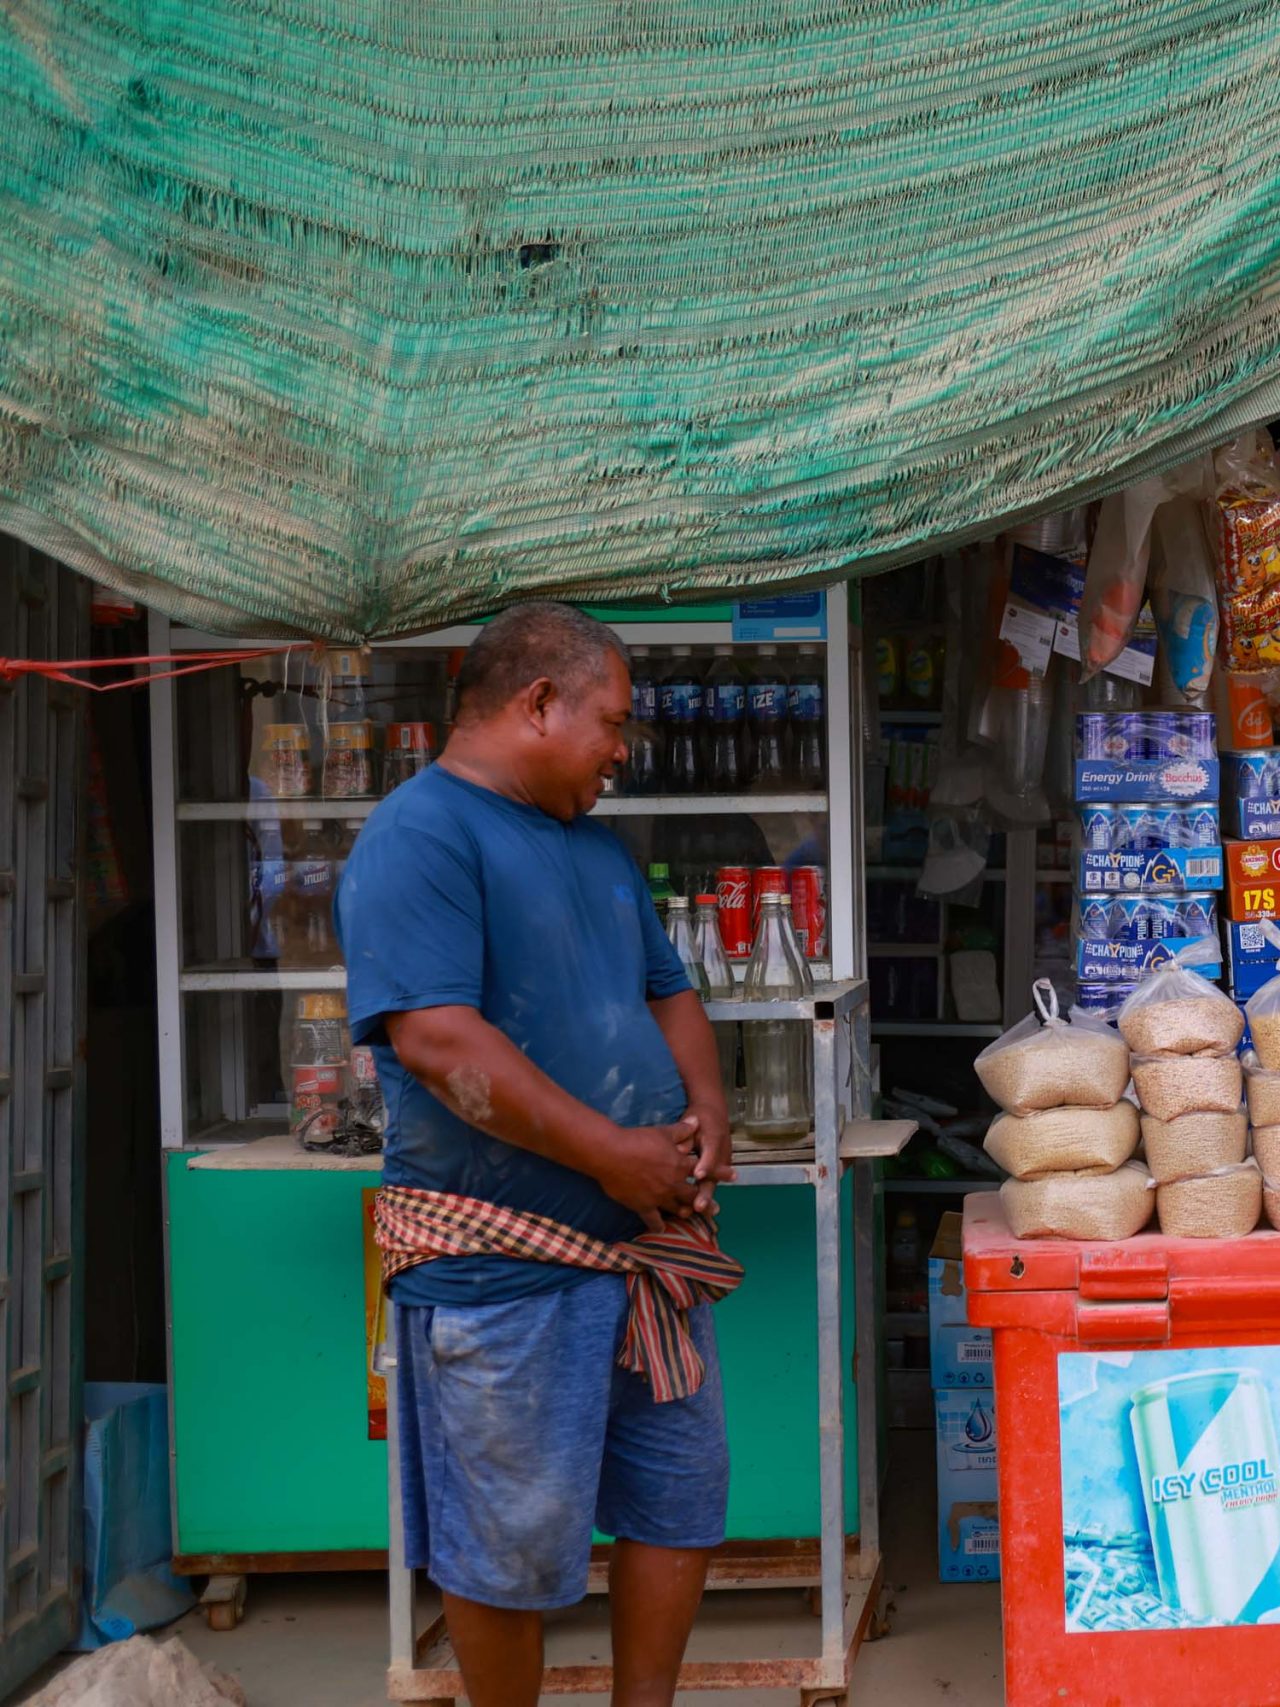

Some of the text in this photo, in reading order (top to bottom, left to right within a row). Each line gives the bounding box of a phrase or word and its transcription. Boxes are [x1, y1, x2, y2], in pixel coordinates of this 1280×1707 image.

[1082, 772, 1123, 785] Energy
[1126, 772, 1157, 783] Drink
[1153, 1458, 1274, 1502] ICY COOL
[1223, 1481, 1277, 1500] MENTHOL
